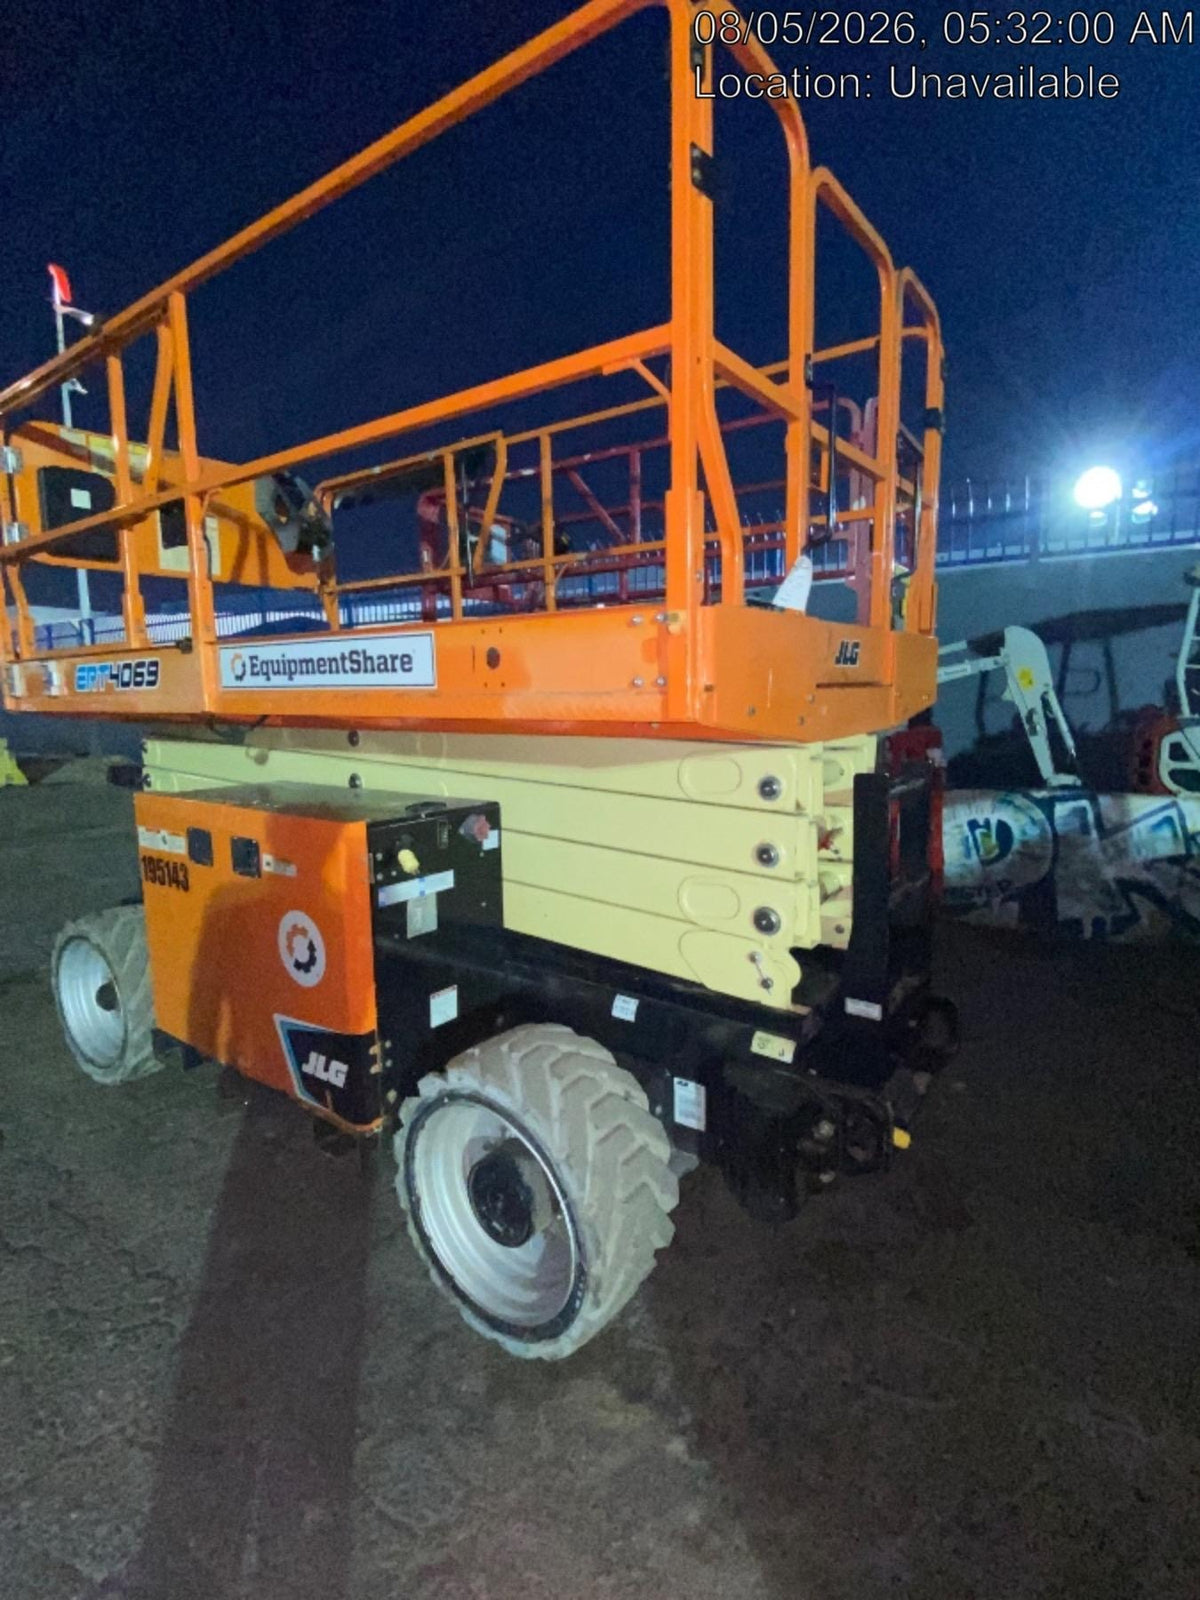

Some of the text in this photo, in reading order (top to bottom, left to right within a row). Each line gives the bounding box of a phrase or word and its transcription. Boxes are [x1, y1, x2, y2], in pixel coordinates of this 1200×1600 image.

[249, 649, 413, 681] EquipmentShare
[835, 641, 860, 665] JLG
[141, 855, 189, 892] 195143
[302, 1051, 349, 1088] JLG
